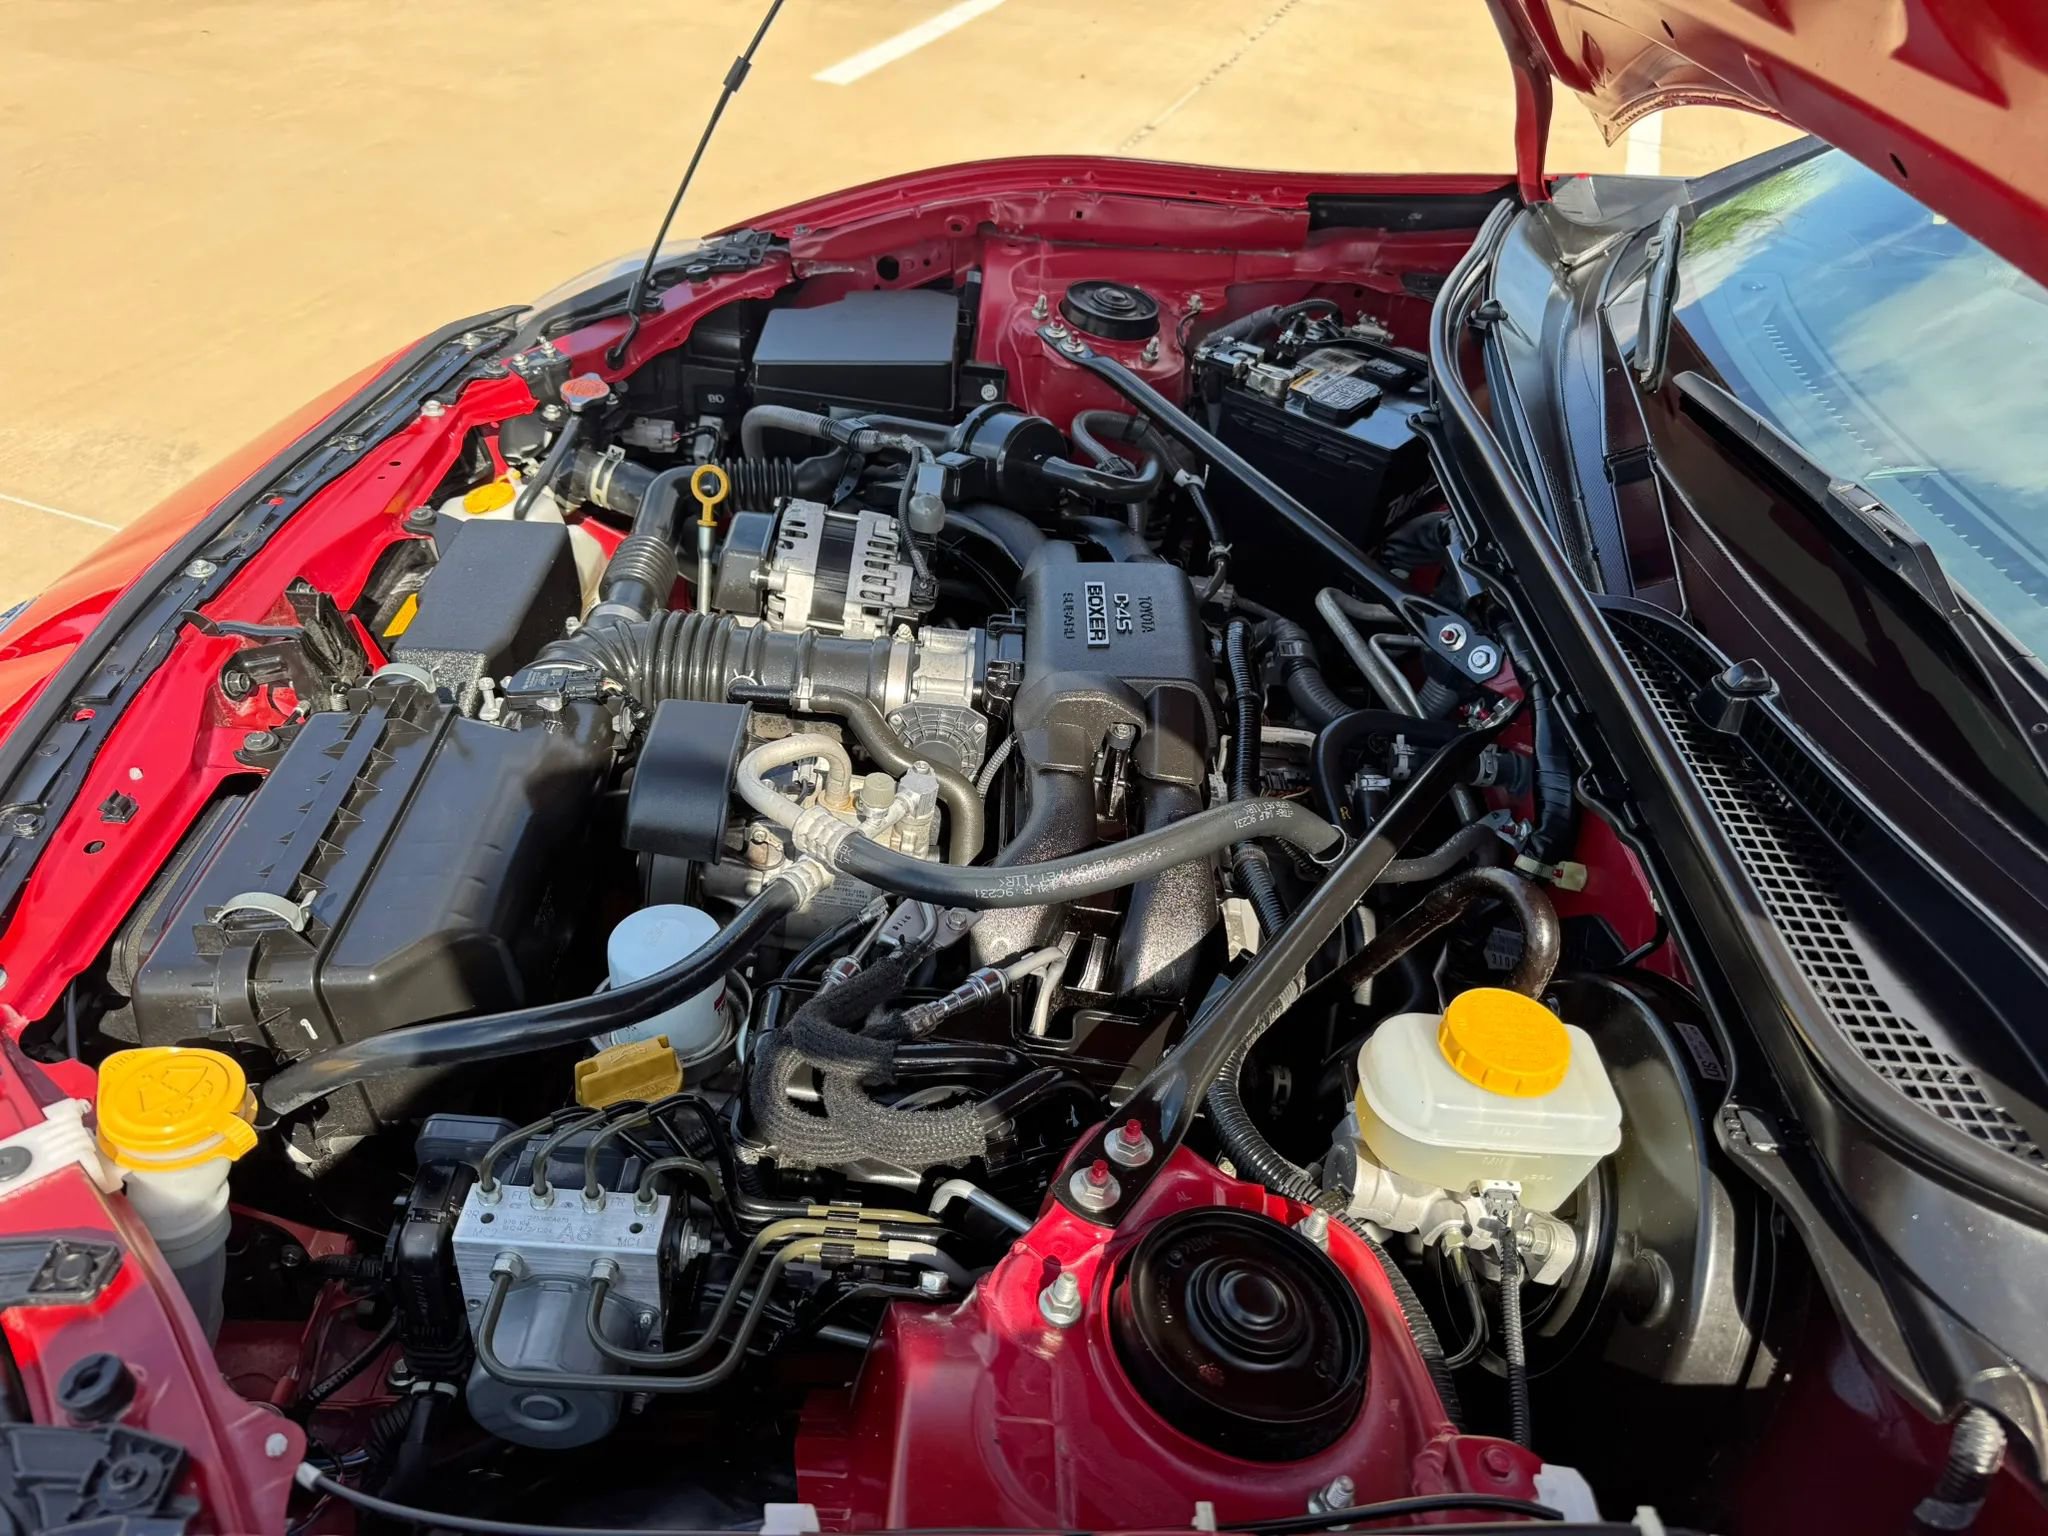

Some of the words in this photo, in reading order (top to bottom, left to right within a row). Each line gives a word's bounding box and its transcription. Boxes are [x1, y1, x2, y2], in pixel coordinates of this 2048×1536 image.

[1062, 592, 1075, 639] SUBARU
[1086, 584, 1107, 641] BOXER
[1138, 596, 1156, 633] TOYOTA
